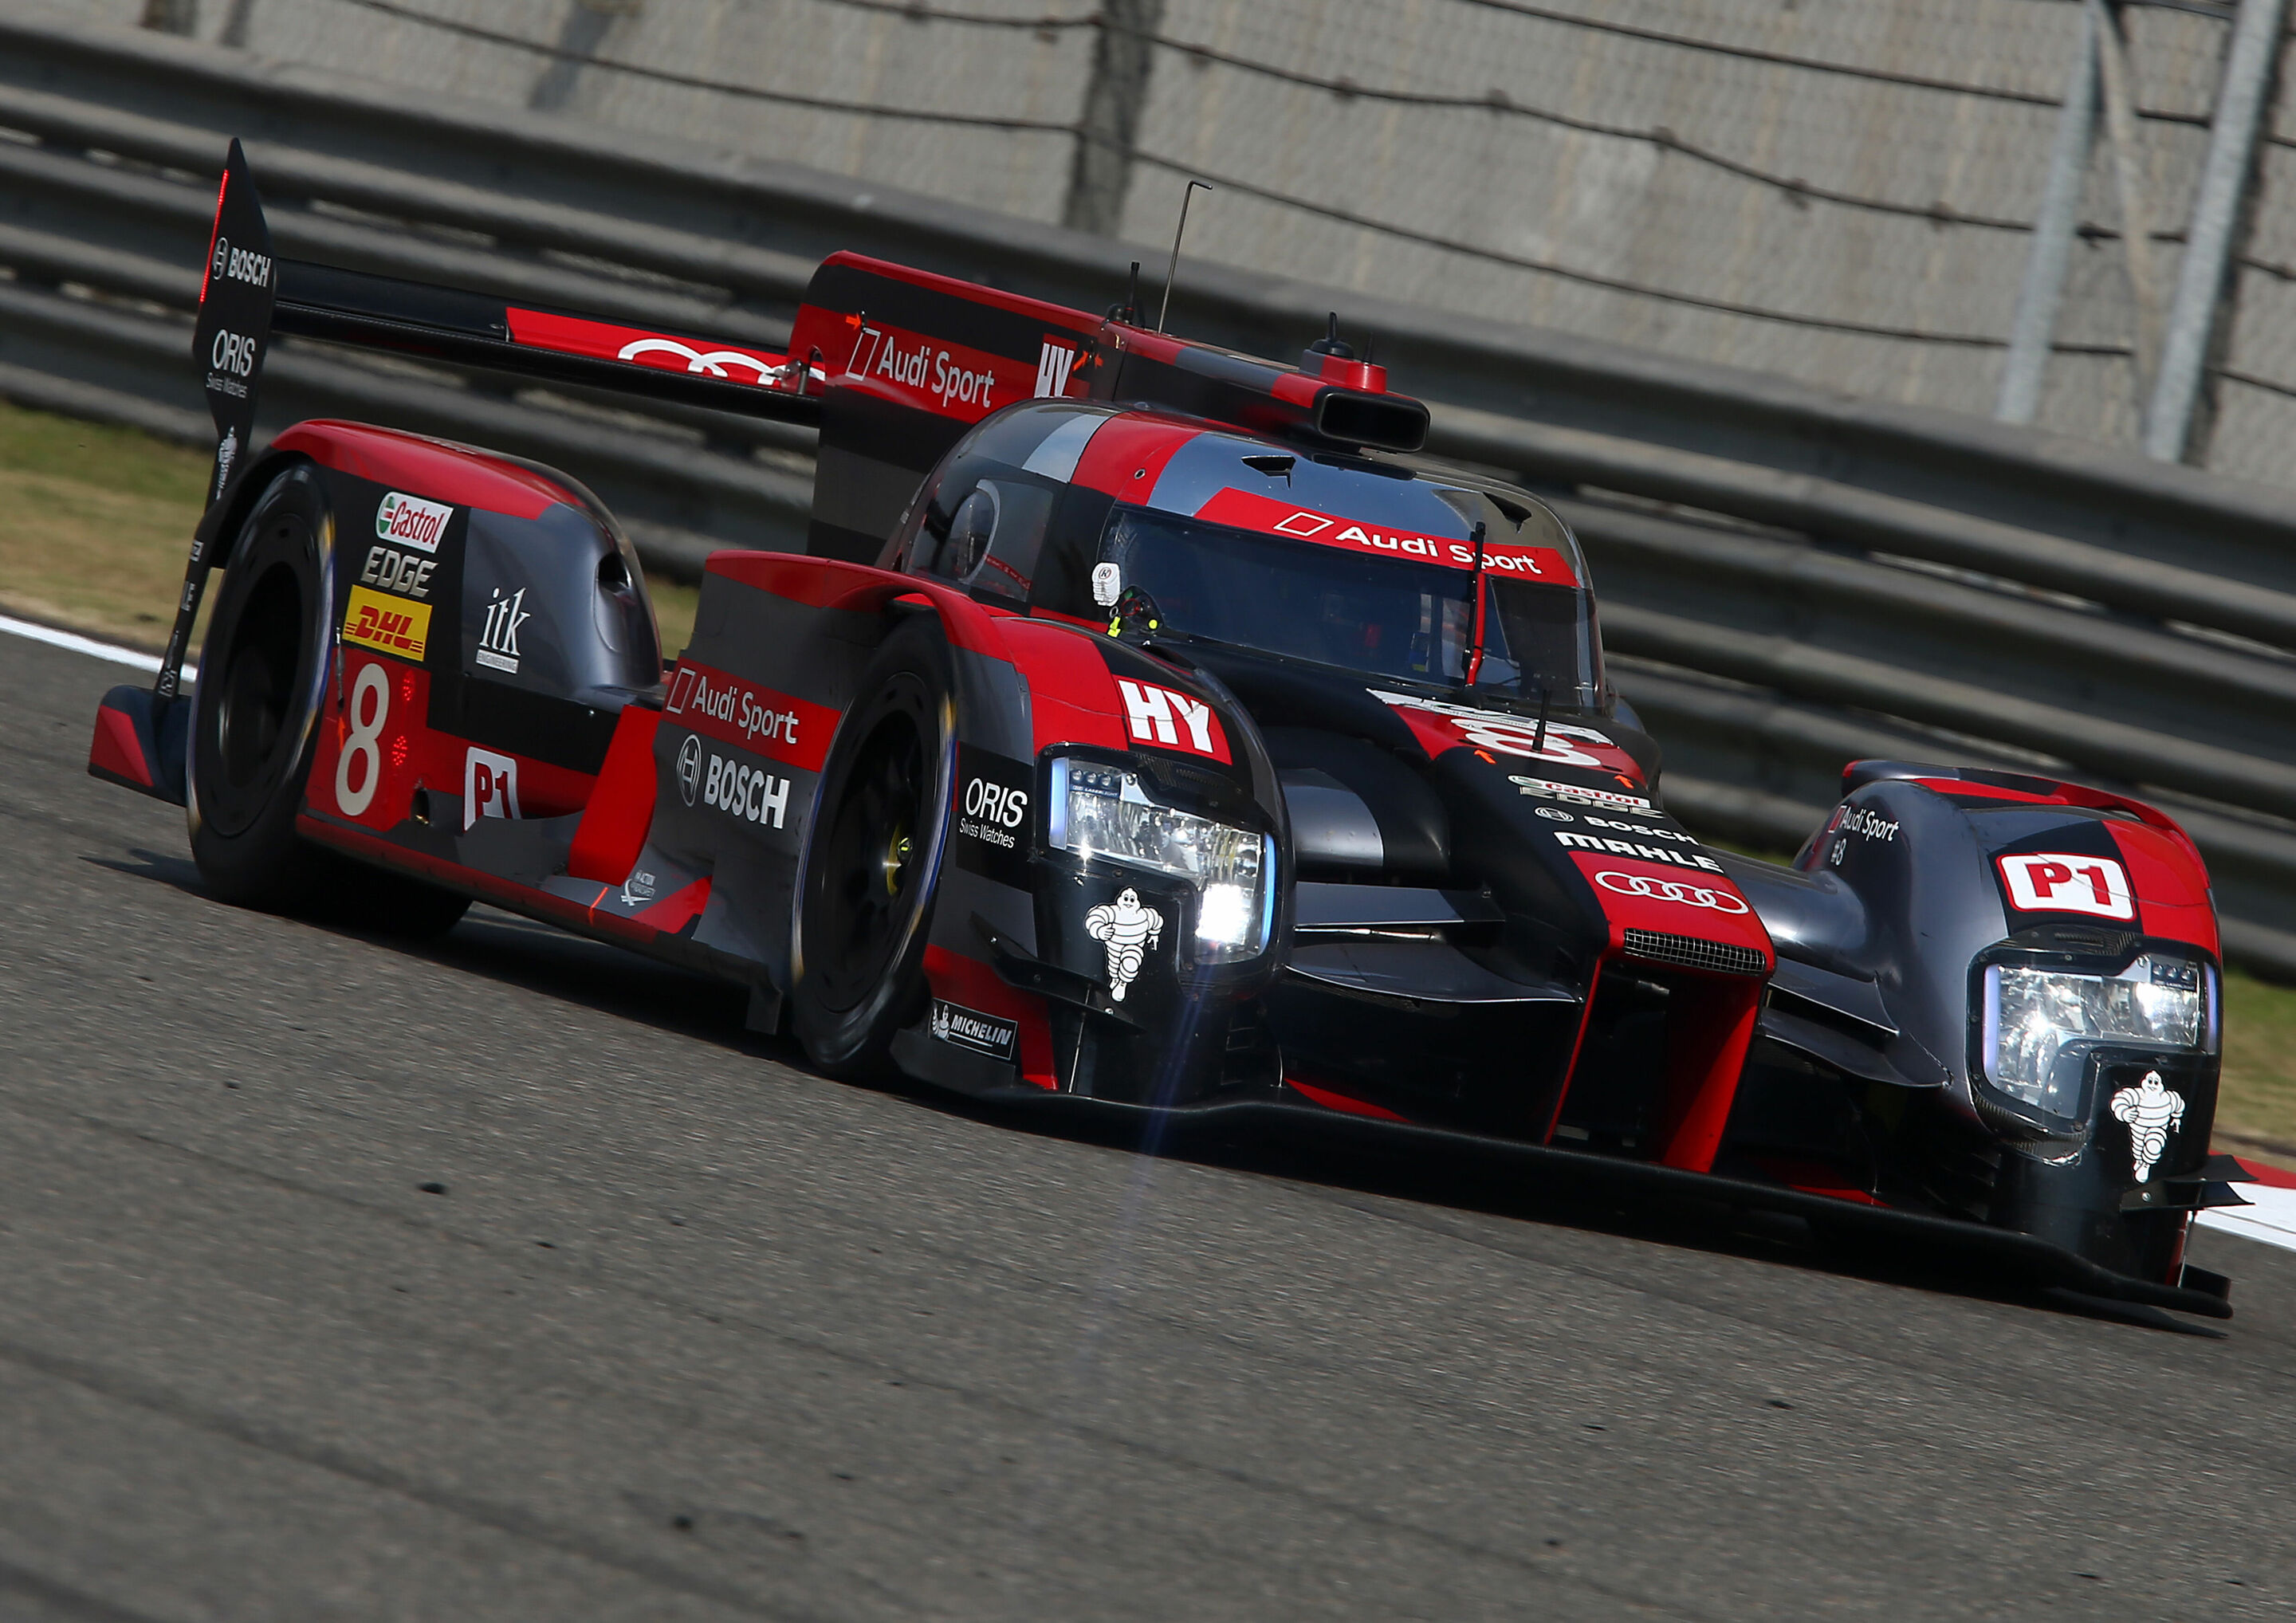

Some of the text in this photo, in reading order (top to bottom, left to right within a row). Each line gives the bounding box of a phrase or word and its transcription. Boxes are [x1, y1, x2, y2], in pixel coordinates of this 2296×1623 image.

[227, 247, 272, 288] BOSCH
[212, 328, 256, 377] ORIS
[876, 336, 995, 408] Audi Sport
[390, 501, 445, 545] Castrol
[360, 546, 438, 598] EDGE
[1335, 526, 1543, 575] Audi Sport
[355, 605, 414, 650] DHL
[479, 588, 530, 656] itk
[691, 676, 799, 745] Audi Sport
[1118, 680, 1214, 753] HY
[336, 663, 390, 816] 8
[1451, 718, 1602, 766] 8
[474, 761, 513, 822] P1
[704, 754, 790, 829] BOSCH
[965, 778, 1028, 827] ORIS
[959, 818, 1015, 848] Swiss Watches
[1583, 815, 1700, 847] BOSCH
[1839, 806, 1899, 842] Audi Sport
[1554, 831, 1724, 874] MAHLE
[2024, 862, 2112, 906] P1
[950, 1014, 1012, 1045] MICHELIN
